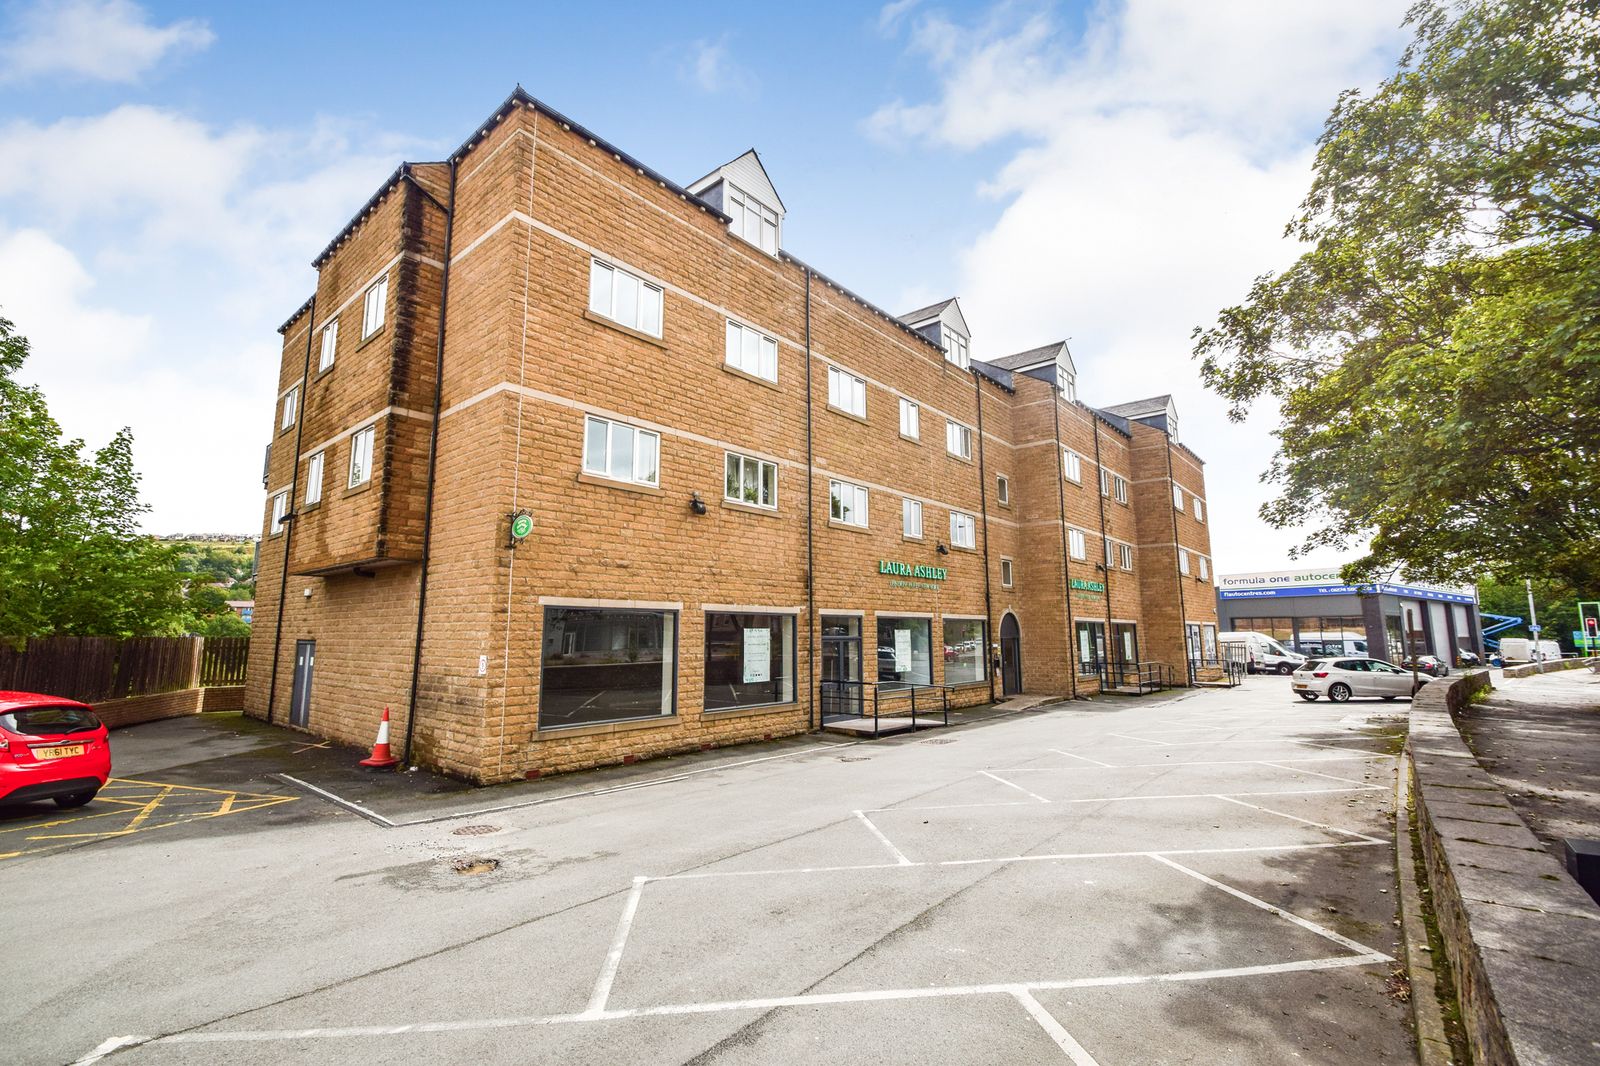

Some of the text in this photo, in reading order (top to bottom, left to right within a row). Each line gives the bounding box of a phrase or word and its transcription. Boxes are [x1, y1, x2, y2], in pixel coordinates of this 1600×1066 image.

[879, 560, 948, 581] LAURA ASHLEY
[1070, 579, 1087, 590] LAURA
[1223, 577, 1265, 585] formula
[64, 746, 80, 755] TYC
